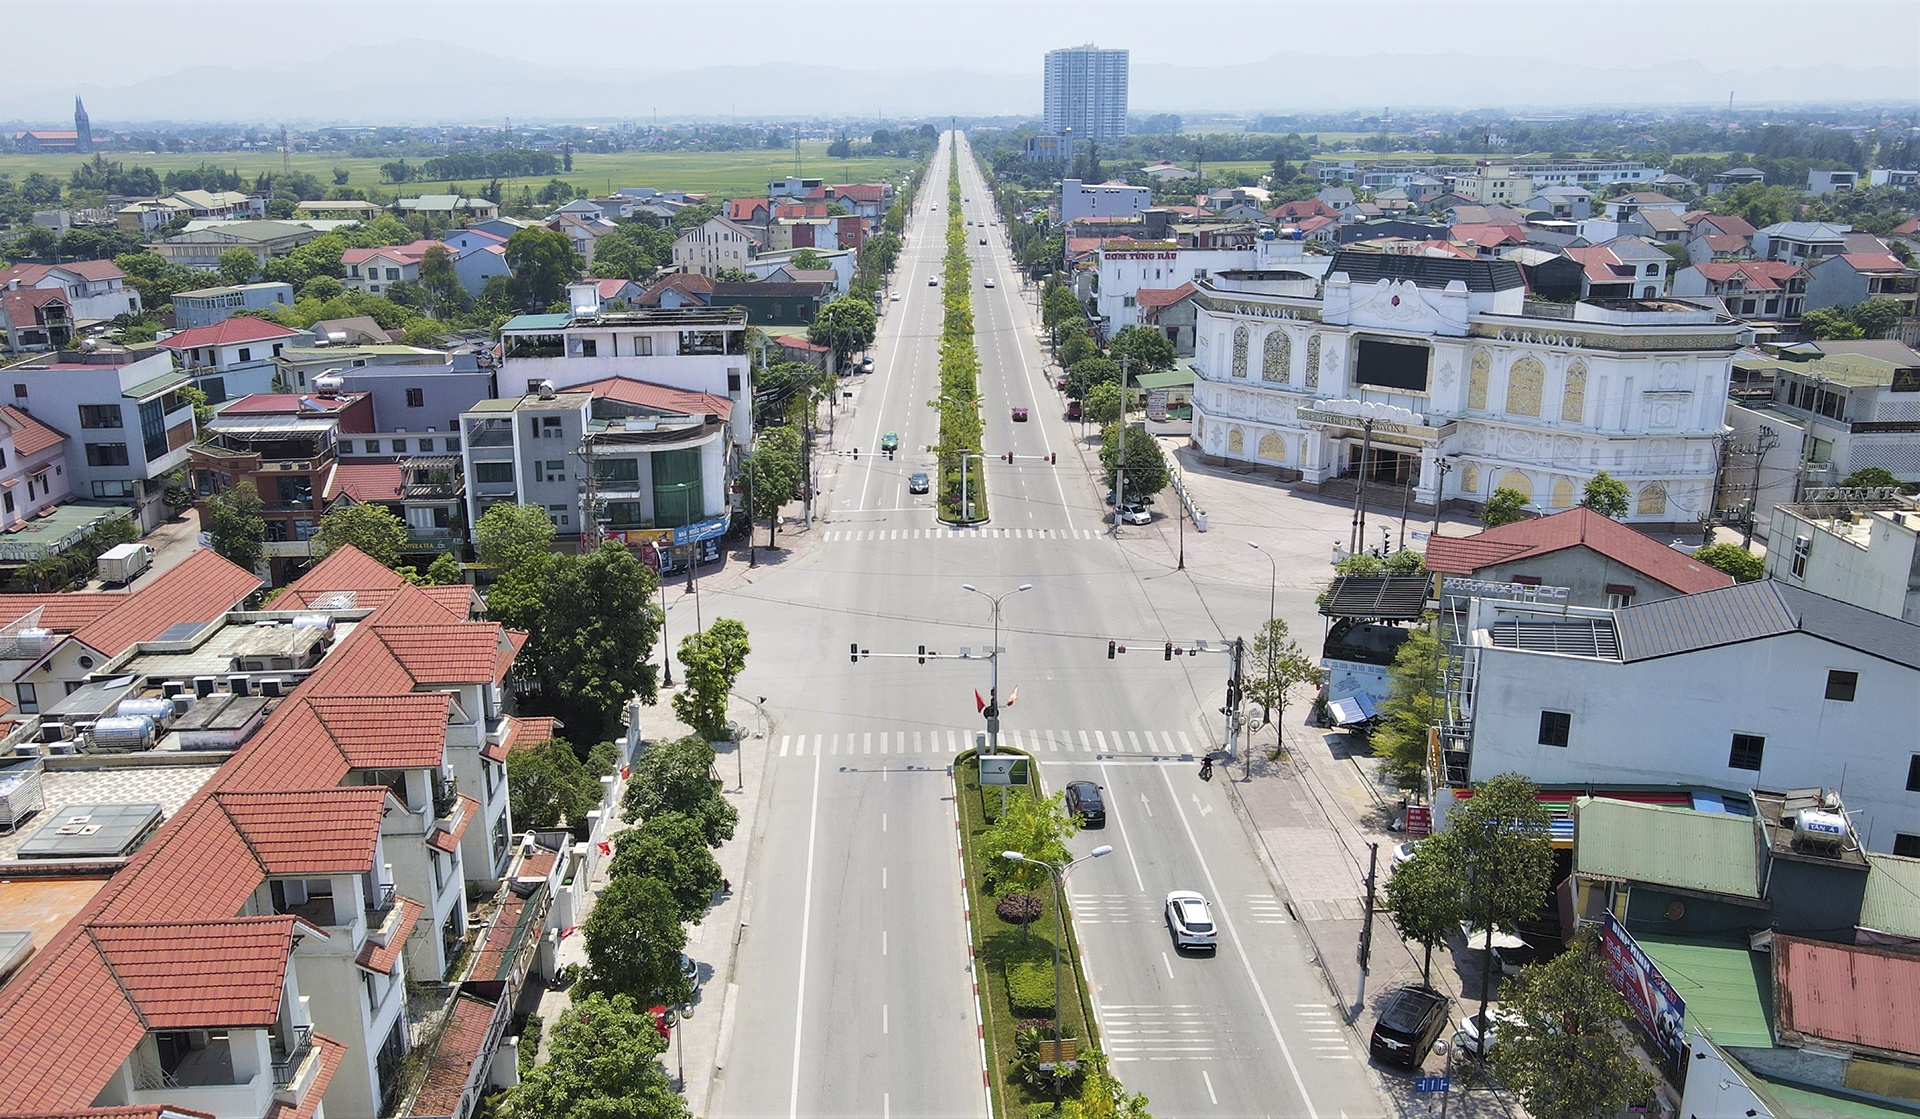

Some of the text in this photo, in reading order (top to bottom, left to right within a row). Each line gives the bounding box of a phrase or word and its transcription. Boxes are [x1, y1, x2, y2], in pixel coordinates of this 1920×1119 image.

[1235, 304, 1301, 321] KARAOKE
[1496, 329, 1583, 349] KARAOKE
[1630, 943, 1650, 973] MINH
